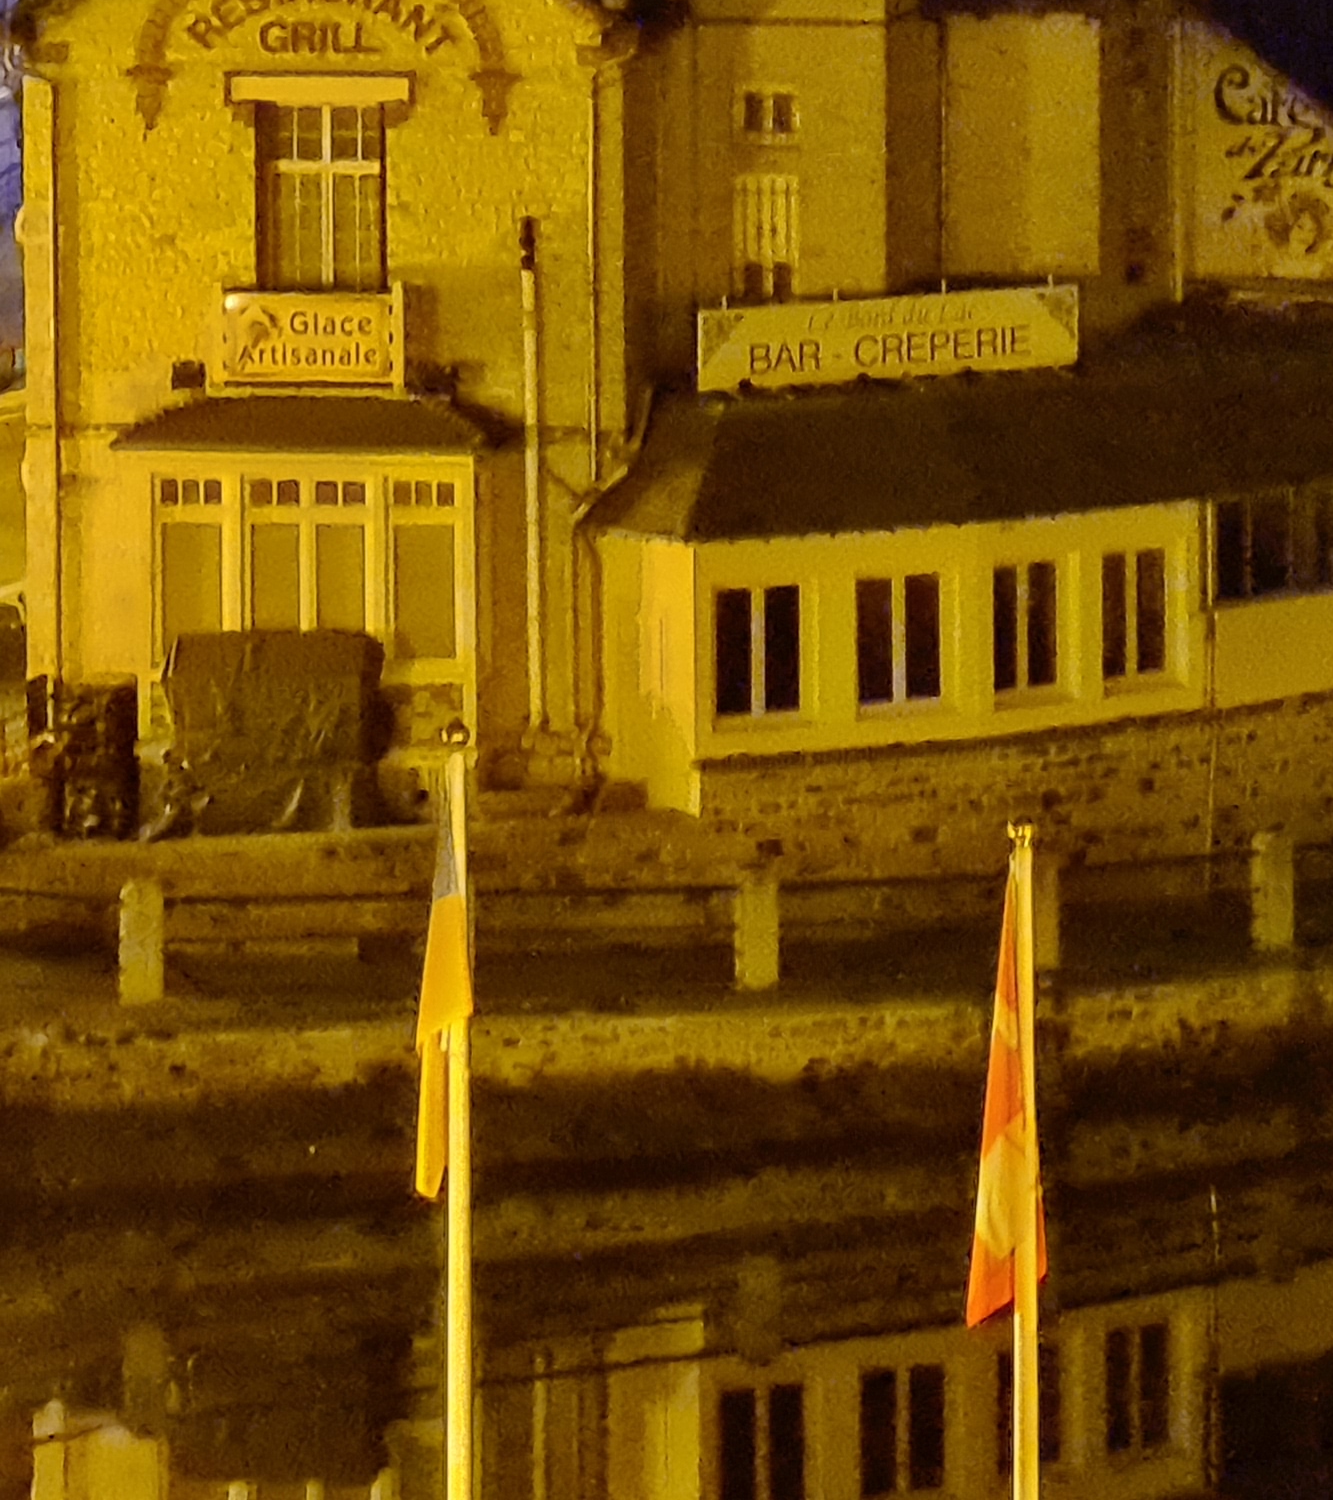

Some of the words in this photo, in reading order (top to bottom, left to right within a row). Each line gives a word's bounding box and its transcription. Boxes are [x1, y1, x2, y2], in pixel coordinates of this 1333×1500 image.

[258, 20, 384, 54] GRILL
[289, 310, 373, 337] Glace
[237, 341, 378, 367] Artisanale
[749, 338, 822, 375] BAR
[853, 323, 1034, 368] CREPERIE
